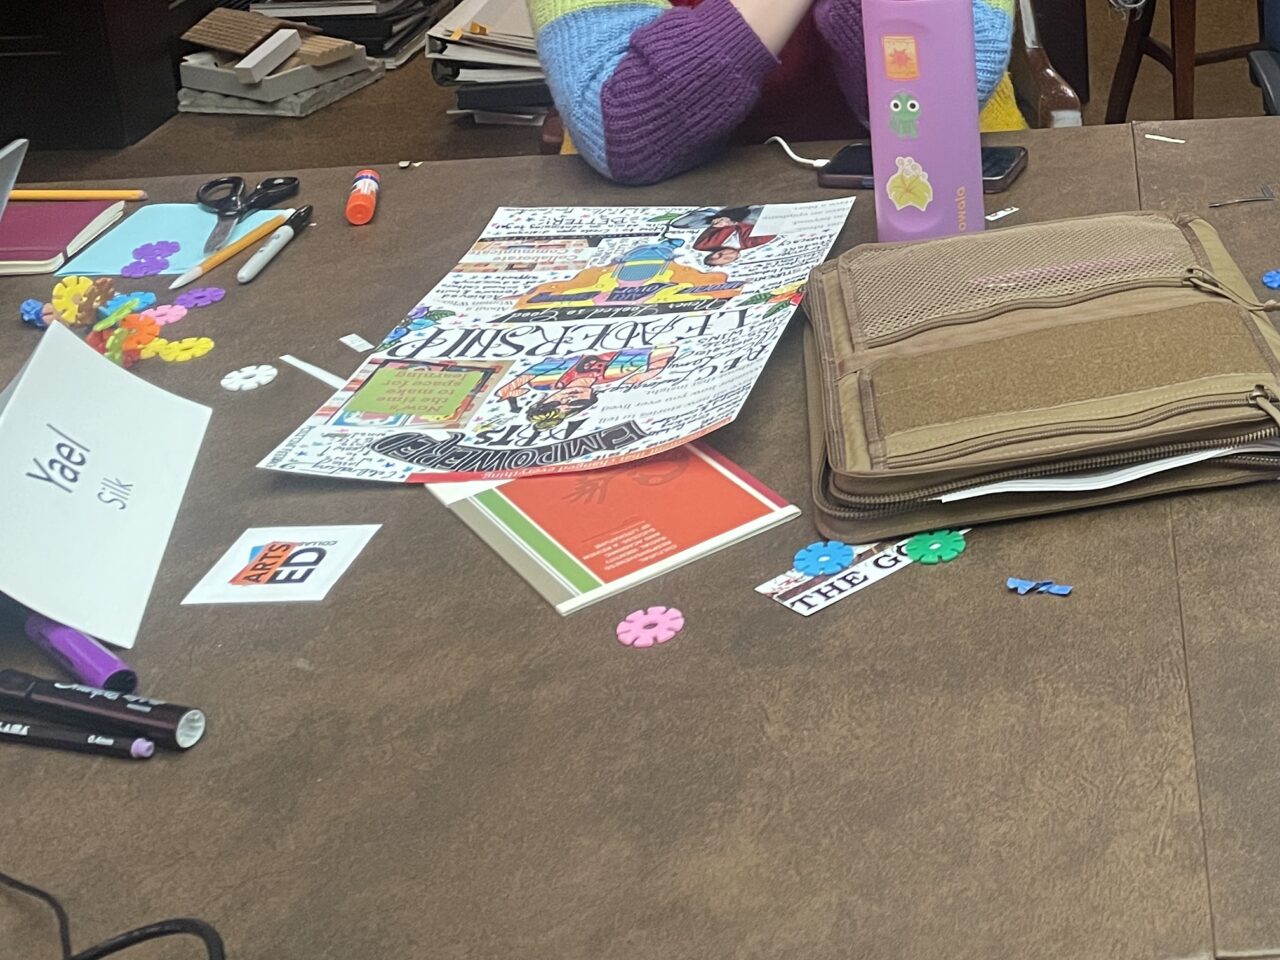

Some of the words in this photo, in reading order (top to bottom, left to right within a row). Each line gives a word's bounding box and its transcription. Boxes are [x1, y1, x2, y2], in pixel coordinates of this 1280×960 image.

[954, 186, 966, 231] owala
[469, 248, 568, 256] Communicate
[505, 311, 558, 322] Good
[586, 305, 659, 318] Looked
[669, 298, 719, 310] Never
[385, 308, 747, 359] LEADERSHIP
[395, 371, 466, 379] learning
[373, 423, 641, 471] EMPOWERED
[474, 417, 588, 450] ARTS
[26, 424, 91, 493] Yael
[480, 464, 557, 481] everything.
[558, 456, 609, 473] changed
[97, 476, 134, 510] Silk
[242, 543, 292, 584] ARTS
[267, 546, 328, 585] ED
[790, 571, 869, 612] THE
